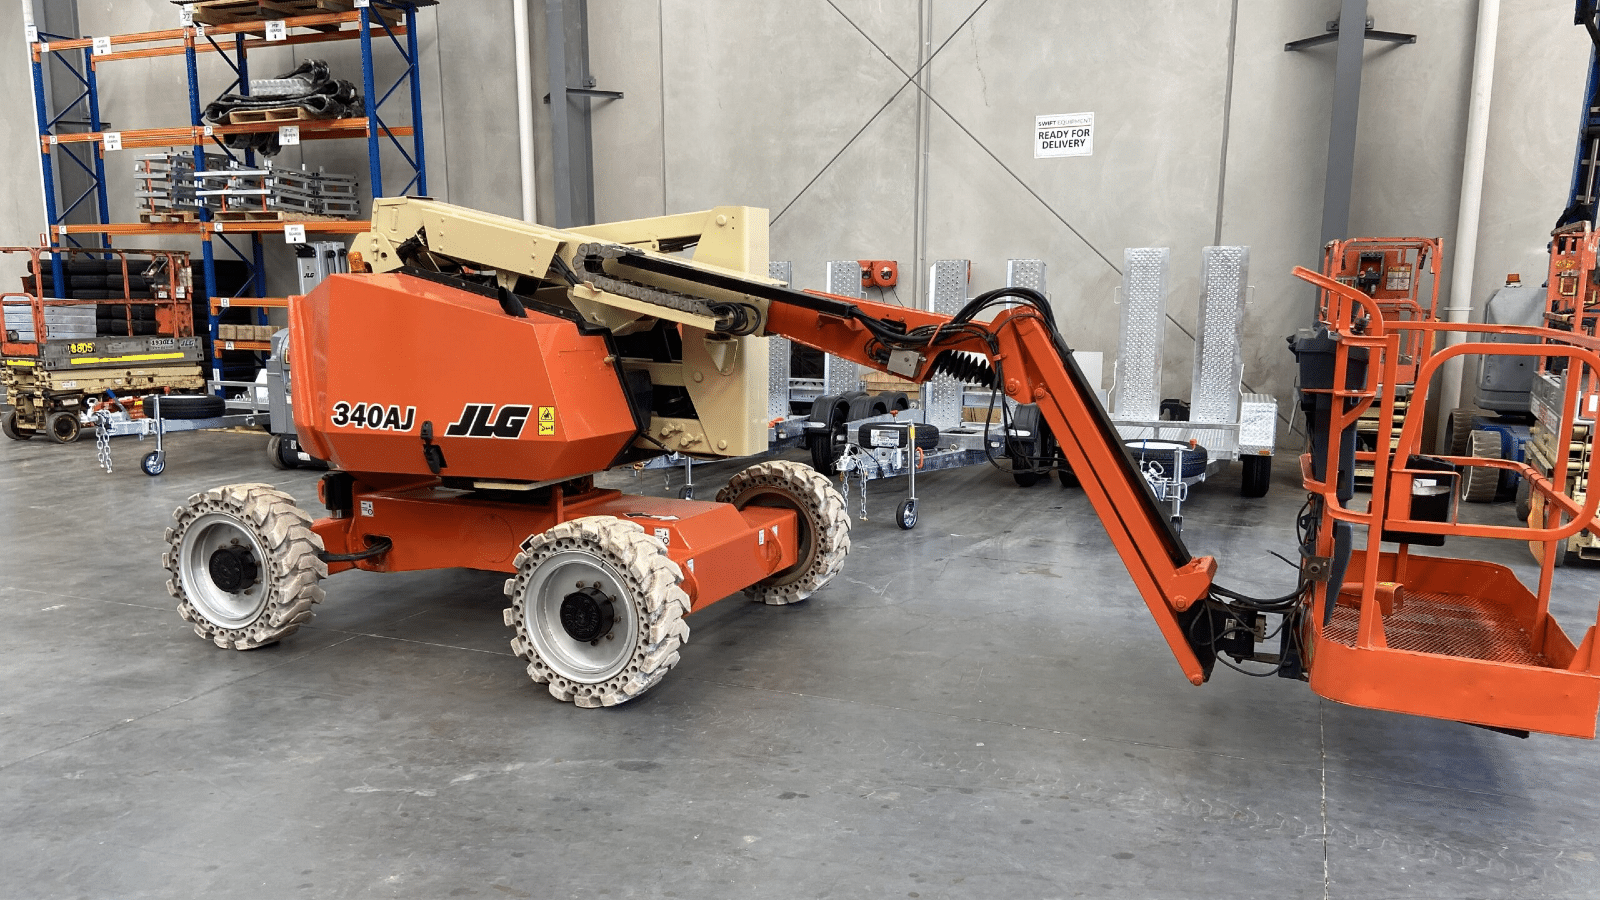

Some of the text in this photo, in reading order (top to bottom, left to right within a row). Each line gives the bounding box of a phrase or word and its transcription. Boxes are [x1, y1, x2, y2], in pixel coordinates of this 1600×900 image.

[205, 127, 211, 135] D
[1038, 128, 1090, 140] READY FOR
[51, 136, 57, 144] D
[1042, 138, 1086, 149] DELIVERY
[215, 223, 221, 231] C
[222, 298, 228, 307] B
[331, 401, 416, 432] 340AJ
[444, 403, 532, 438] JLG
